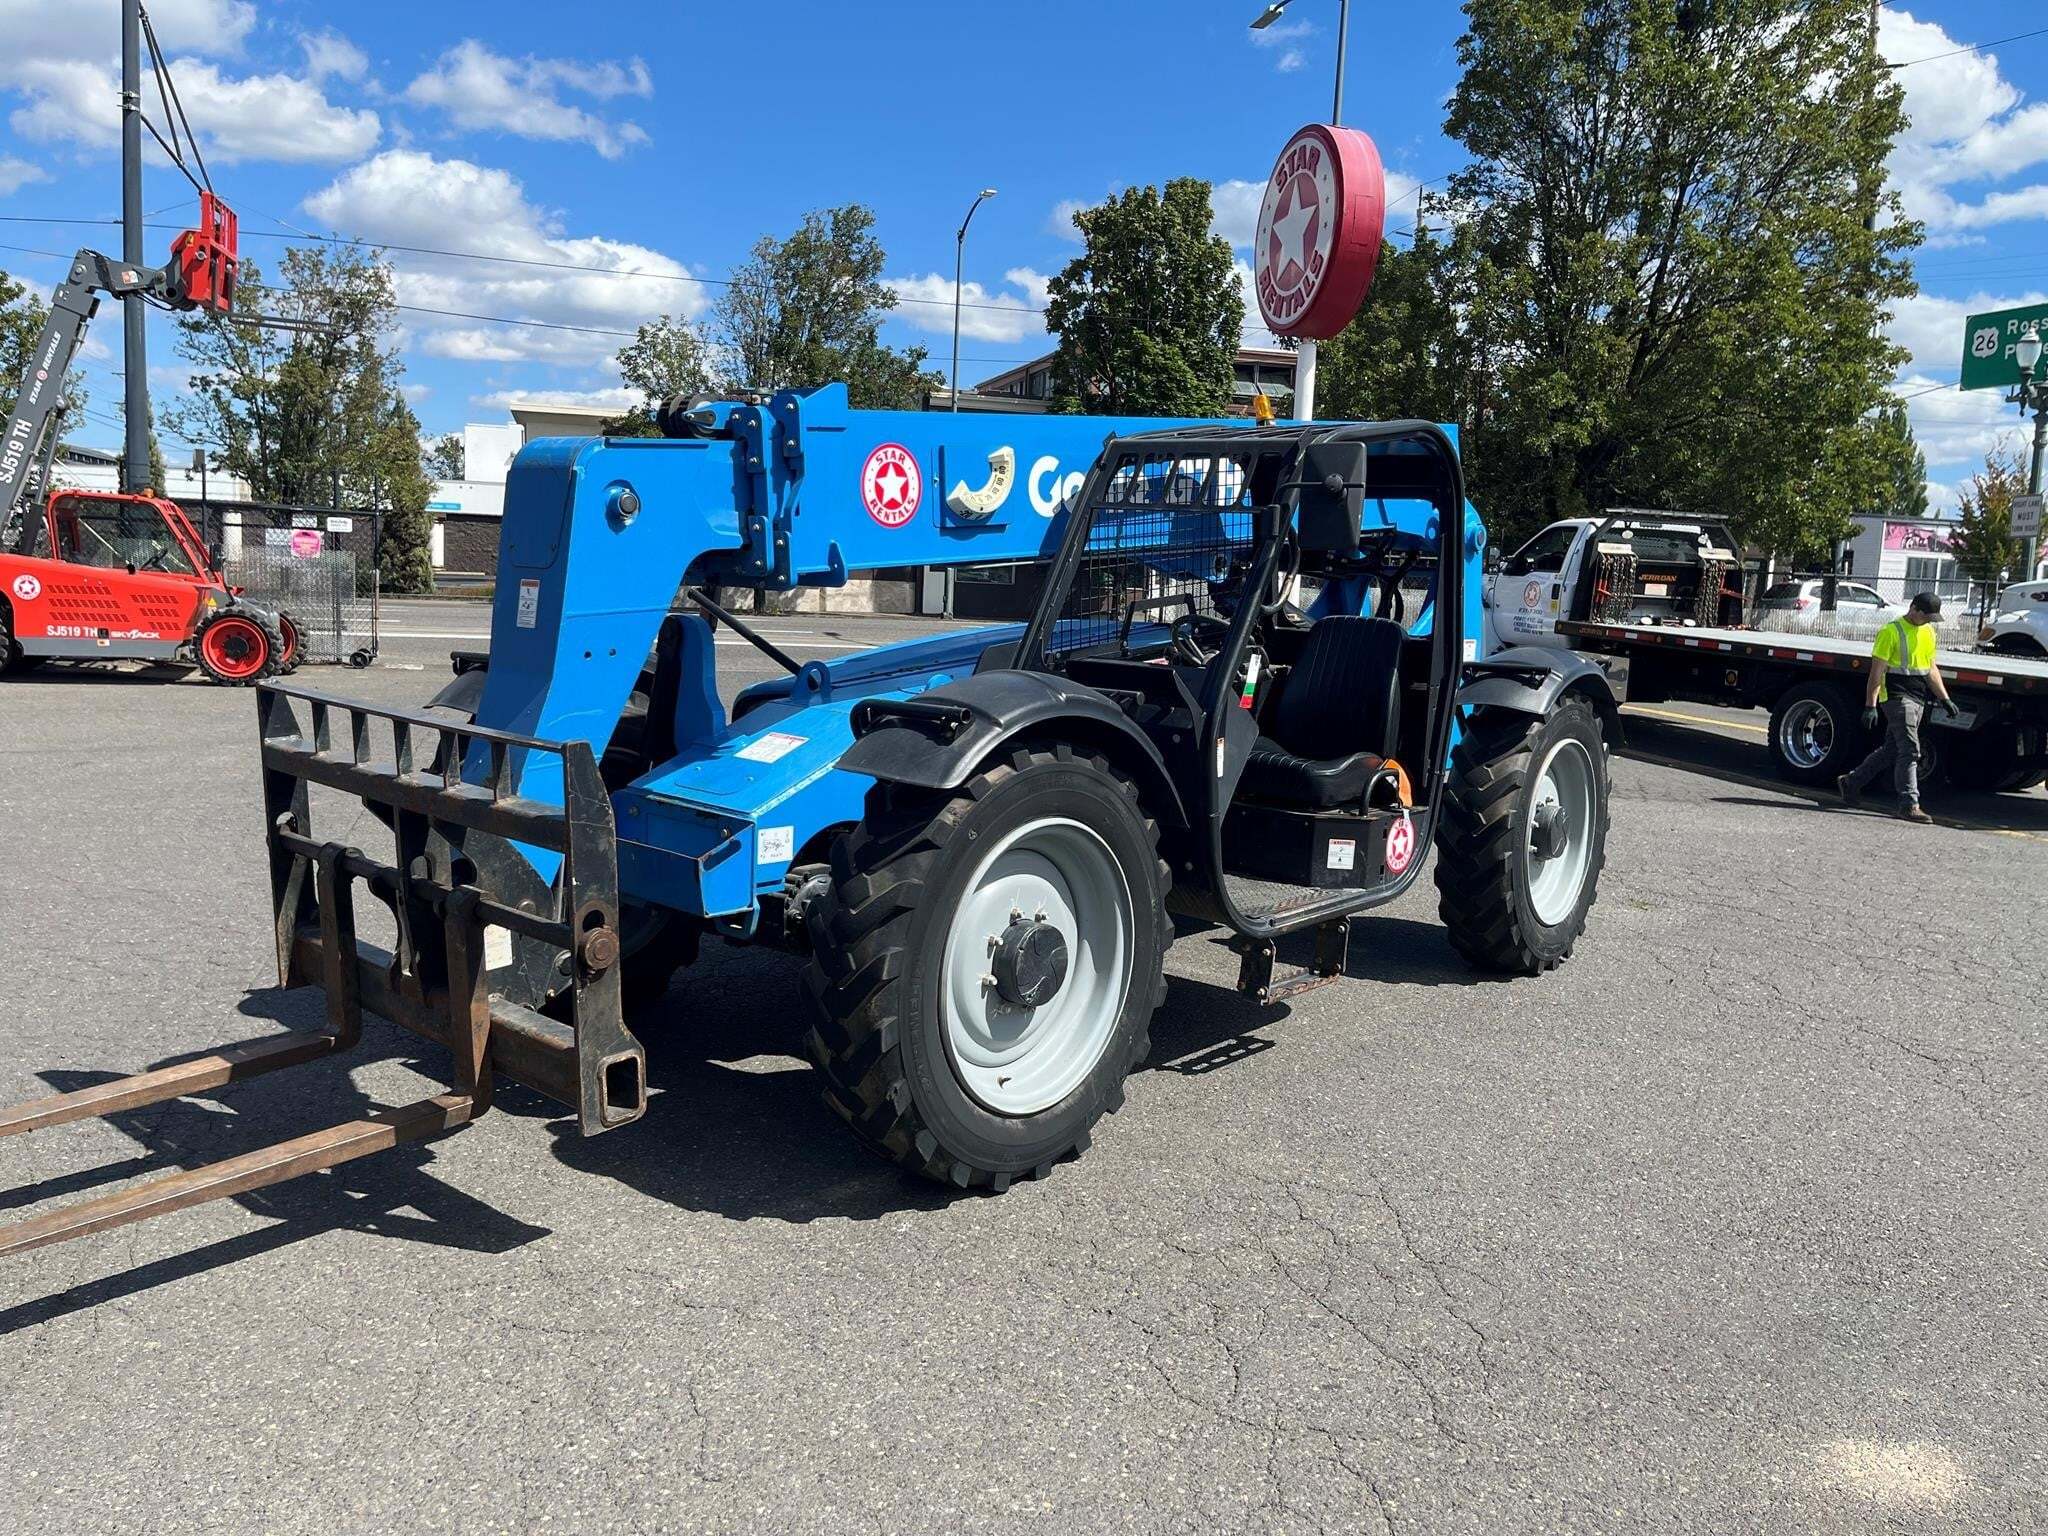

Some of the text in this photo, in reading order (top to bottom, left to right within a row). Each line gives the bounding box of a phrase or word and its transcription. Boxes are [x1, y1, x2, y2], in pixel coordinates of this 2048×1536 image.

[1275, 144, 1321, 193] STAR
[1259, 250, 1324, 319] RENTALS
[1975, 333, 1996, 352] 26
[28, 331, 62, 405] STAR RENTALS
[0, 418, 33, 484] SJ519 TH
[875, 450, 906, 466] STAR
[870, 497, 915, 521] RENTALS
[2017, 511, 2034, 521] MUST
[47, 625, 81, 637] SJ519
[82, 627, 98, 638] TH
